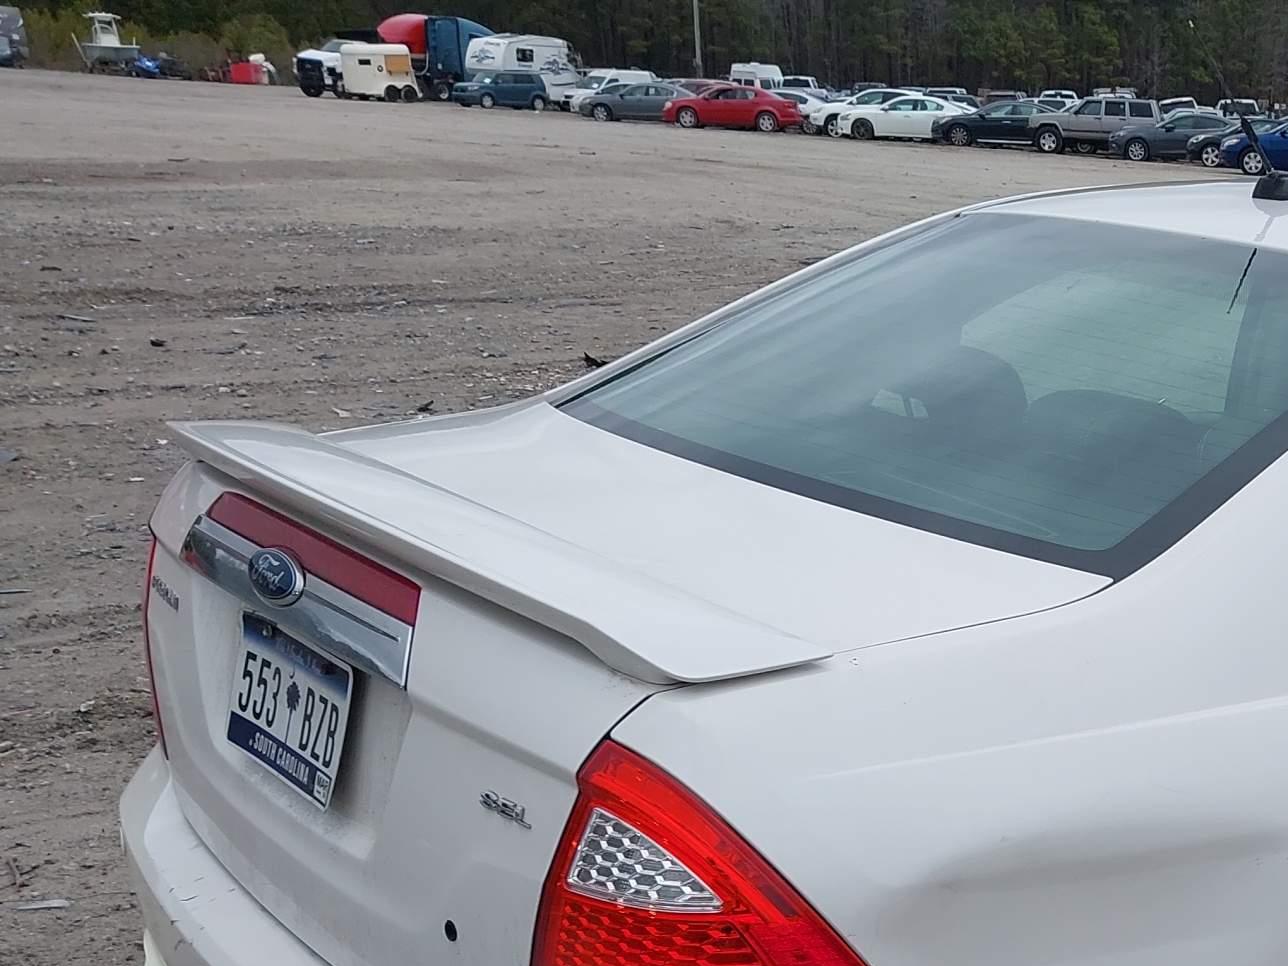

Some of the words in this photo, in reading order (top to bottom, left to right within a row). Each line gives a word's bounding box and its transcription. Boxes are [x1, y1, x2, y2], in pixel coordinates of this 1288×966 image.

[252, 554, 287, 591] Ford
[238, 650, 282, 728] 553
[298, 686, 340, 769] BZB
[253, 732, 278, 761] SOUTH
[276, 748, 310, 785] CAROLINA
[479, 789, 532, 830] SEL
